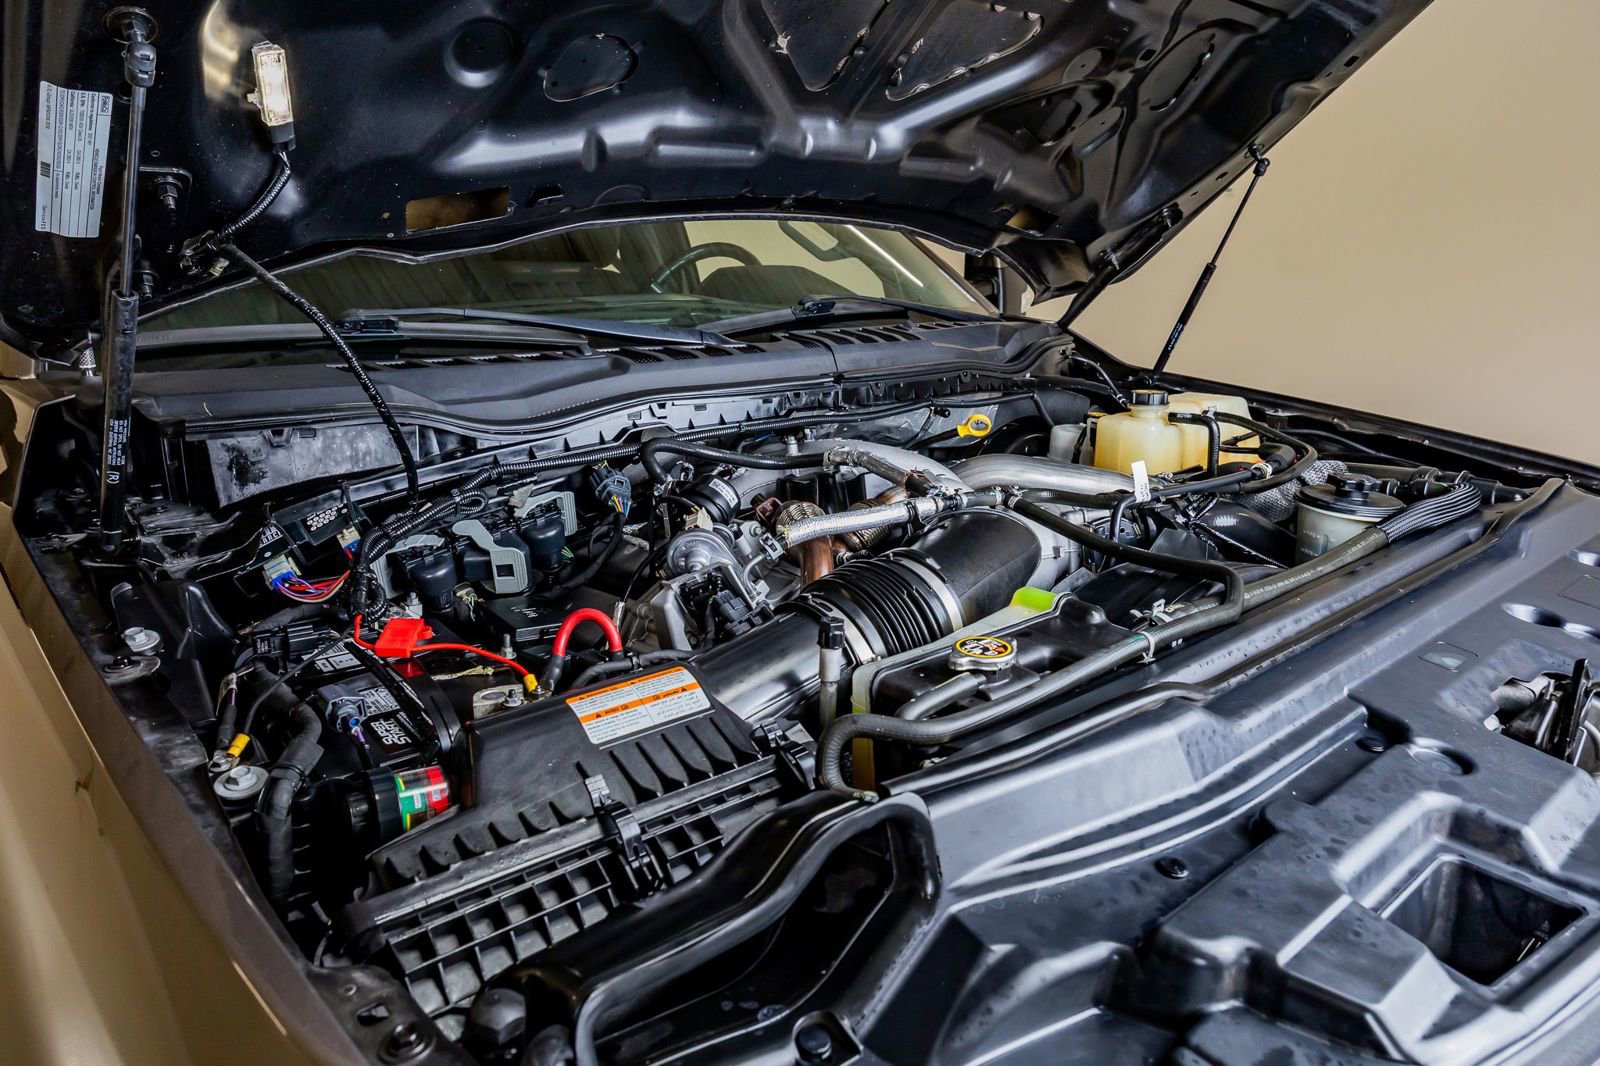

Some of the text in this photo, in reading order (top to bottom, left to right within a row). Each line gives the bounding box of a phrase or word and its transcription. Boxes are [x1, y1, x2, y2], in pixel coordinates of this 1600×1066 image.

[106, 471, 120, 484] (R)
[370, 720, 396, 745] SUPER
[380, 718, 412, 745] START
